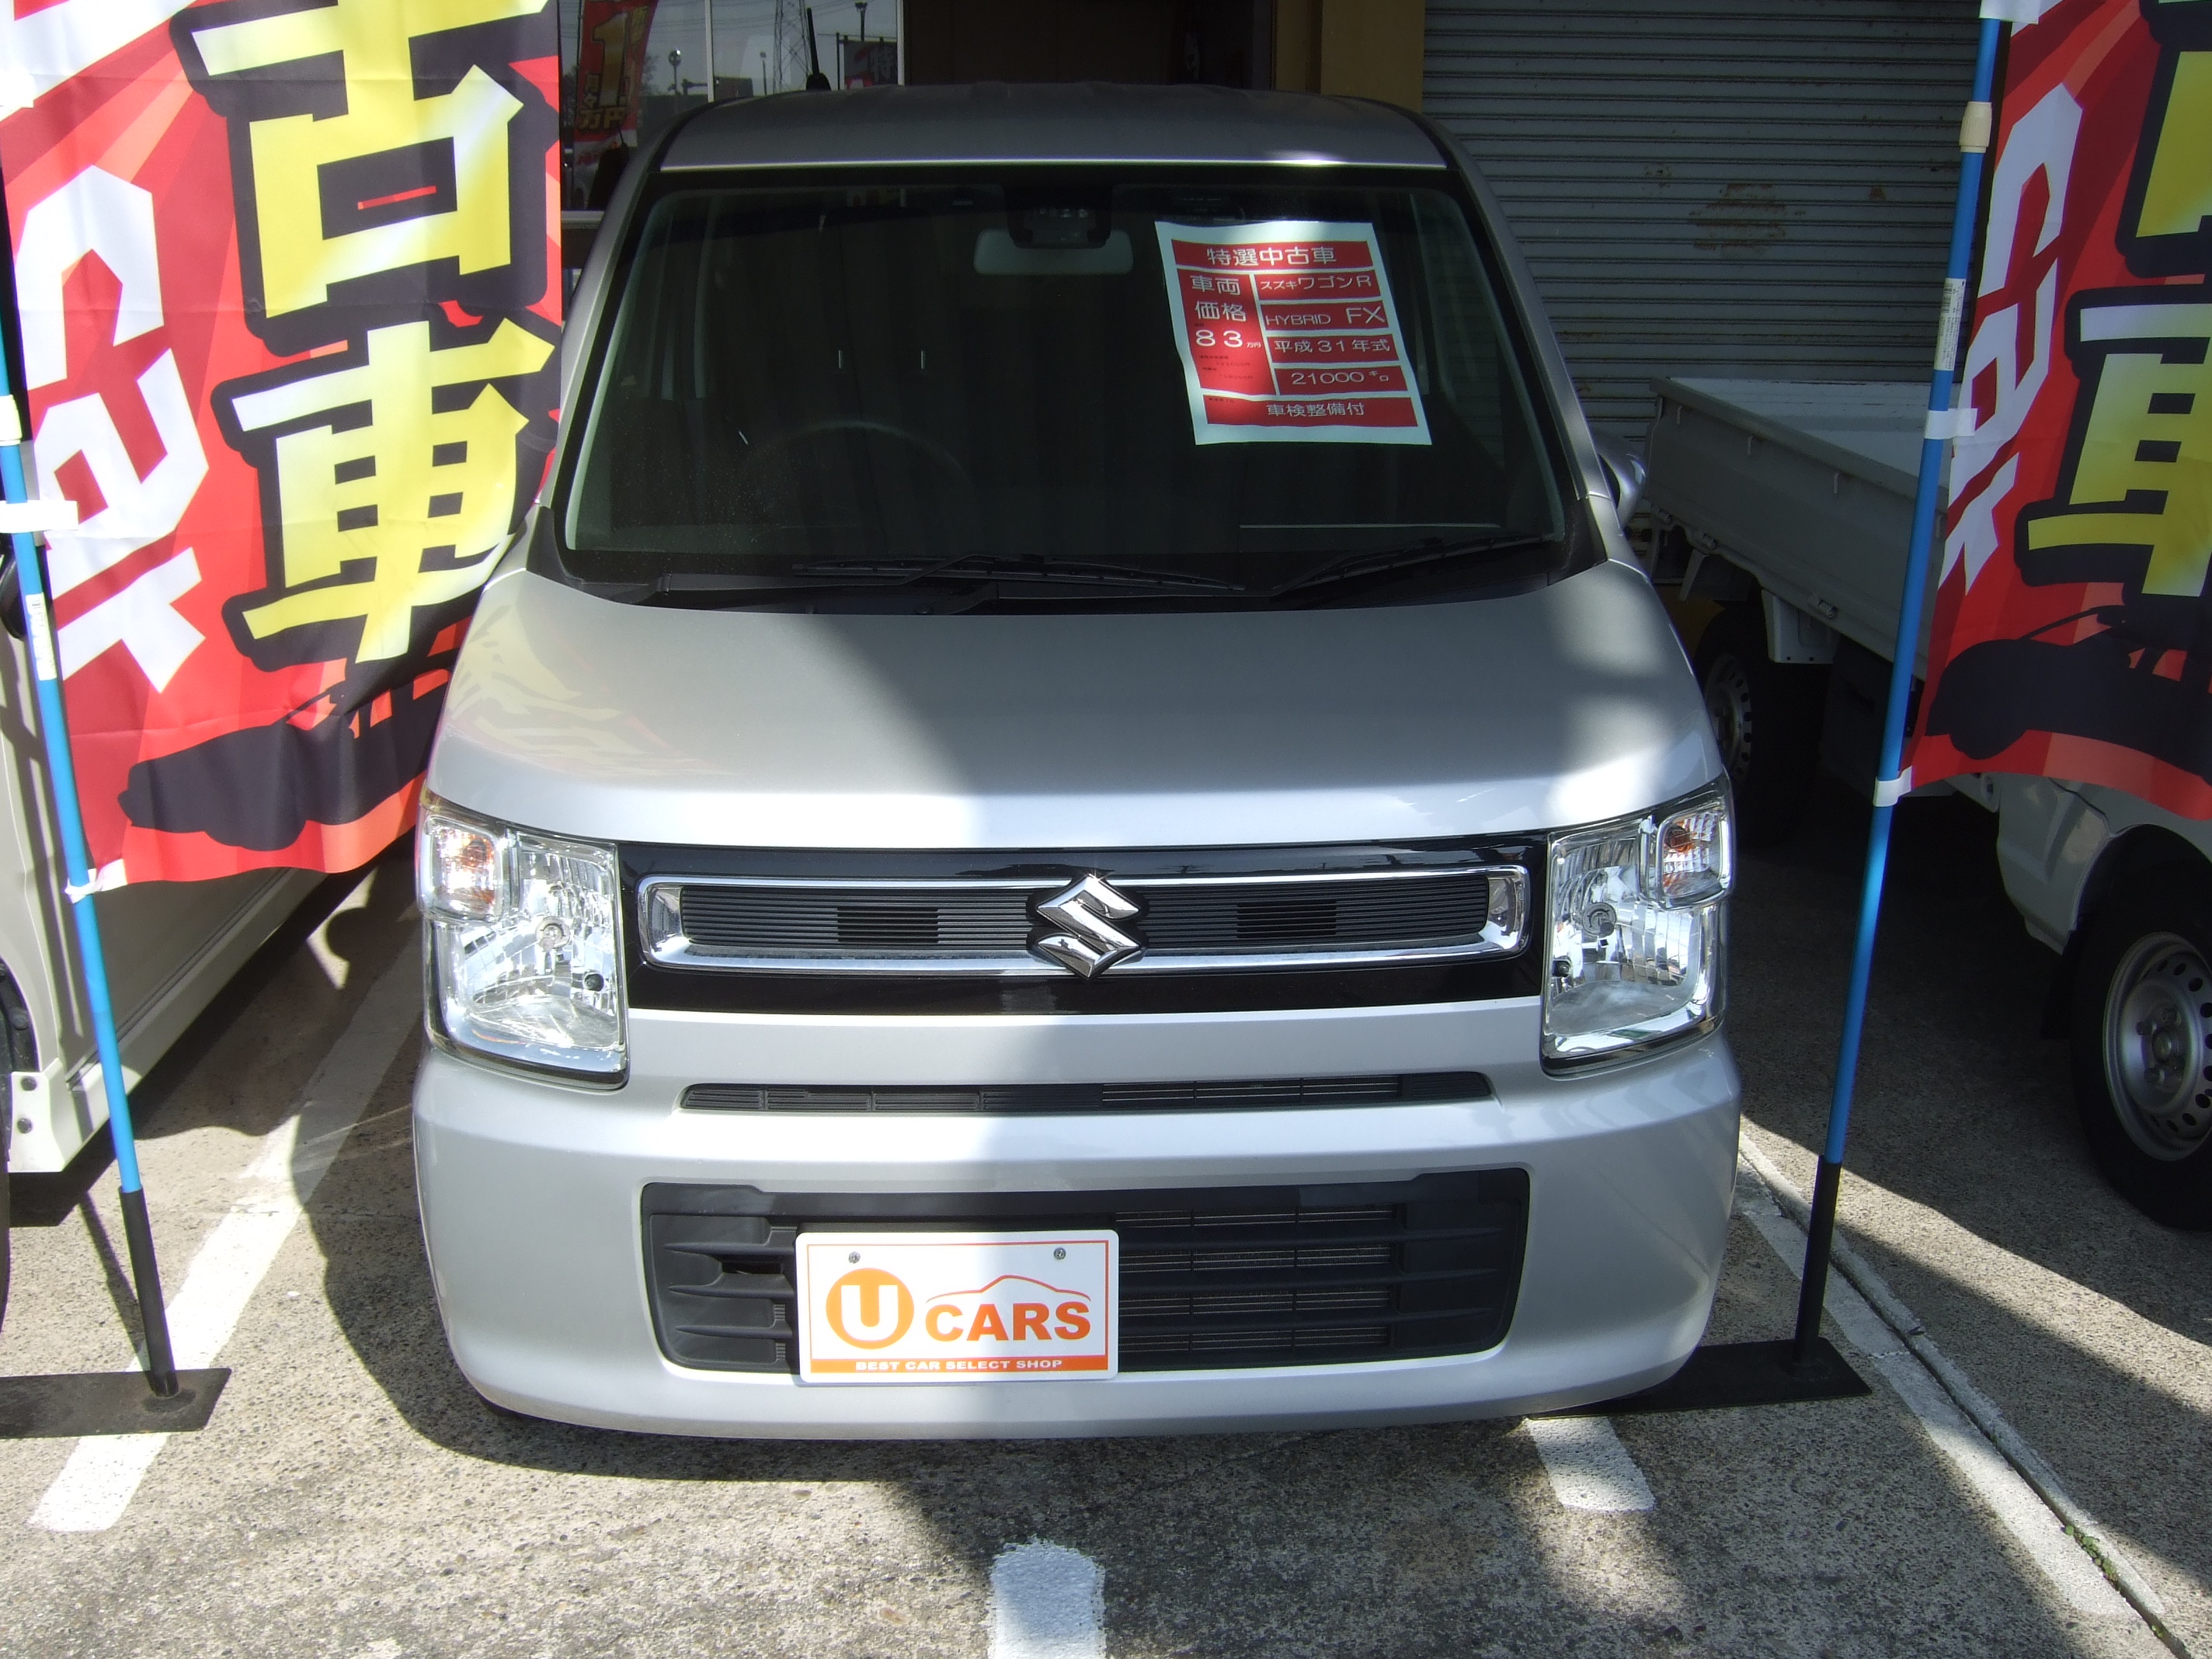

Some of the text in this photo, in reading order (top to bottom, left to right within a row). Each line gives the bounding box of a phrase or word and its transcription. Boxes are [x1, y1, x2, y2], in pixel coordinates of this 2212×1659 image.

[1206, 246, 1337, 266] 特選中古車
[1190, 275, 1241, 296] 車両
[1260, 275, 1372, 290] スズキワゴンR
[1194, 301, 1247, 322] 価格
[1265, 305, 1386, 326] HYBRID FX
[1275, 339, 1390, 353] 平成31年式
[1266, 402, 1365, 417] 車検整備付
[840, 1284, 1091, 1342] U CARS
[855, 1359, 1063, 1371] BEST CAR SELECT SHOP
